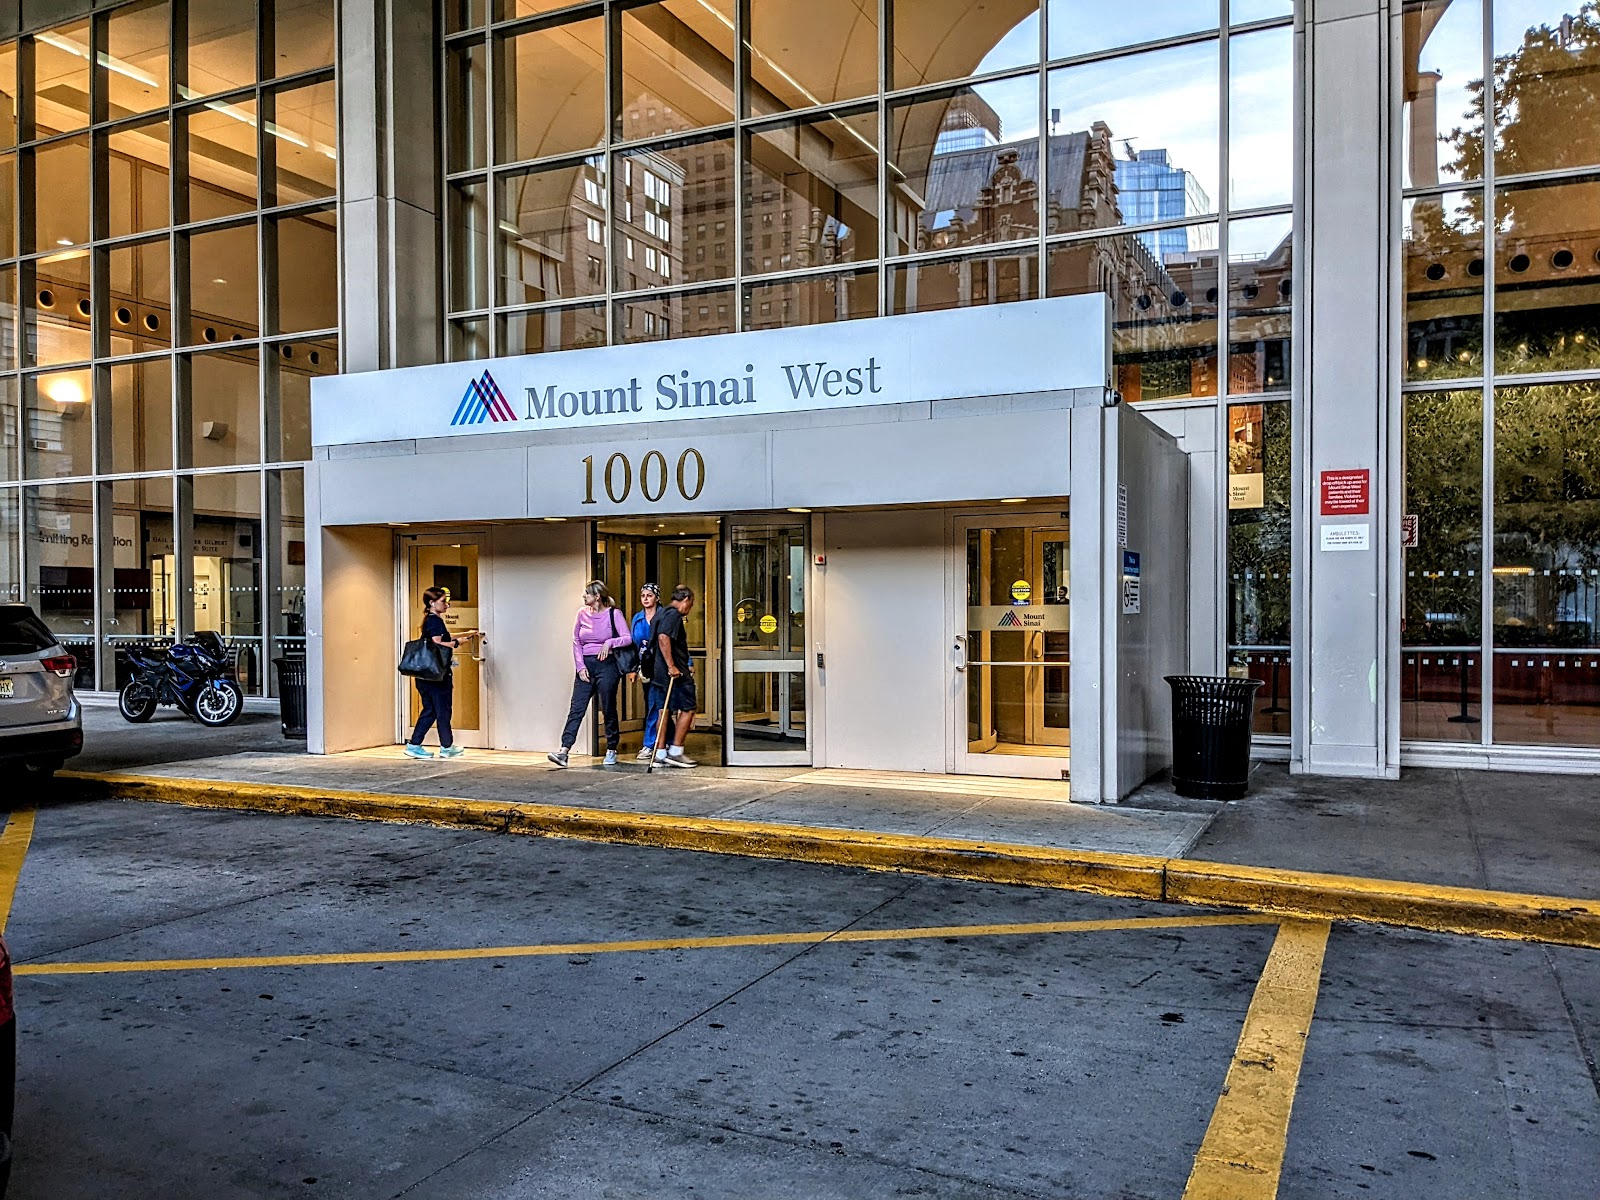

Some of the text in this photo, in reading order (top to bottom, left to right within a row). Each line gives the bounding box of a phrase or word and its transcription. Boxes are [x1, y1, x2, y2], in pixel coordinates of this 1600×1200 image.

[524, 356, 882, 420] Mount Sinai West
[580, 447, 706, 504] 1000
[38, 530, 132, 547] mitting Retion
